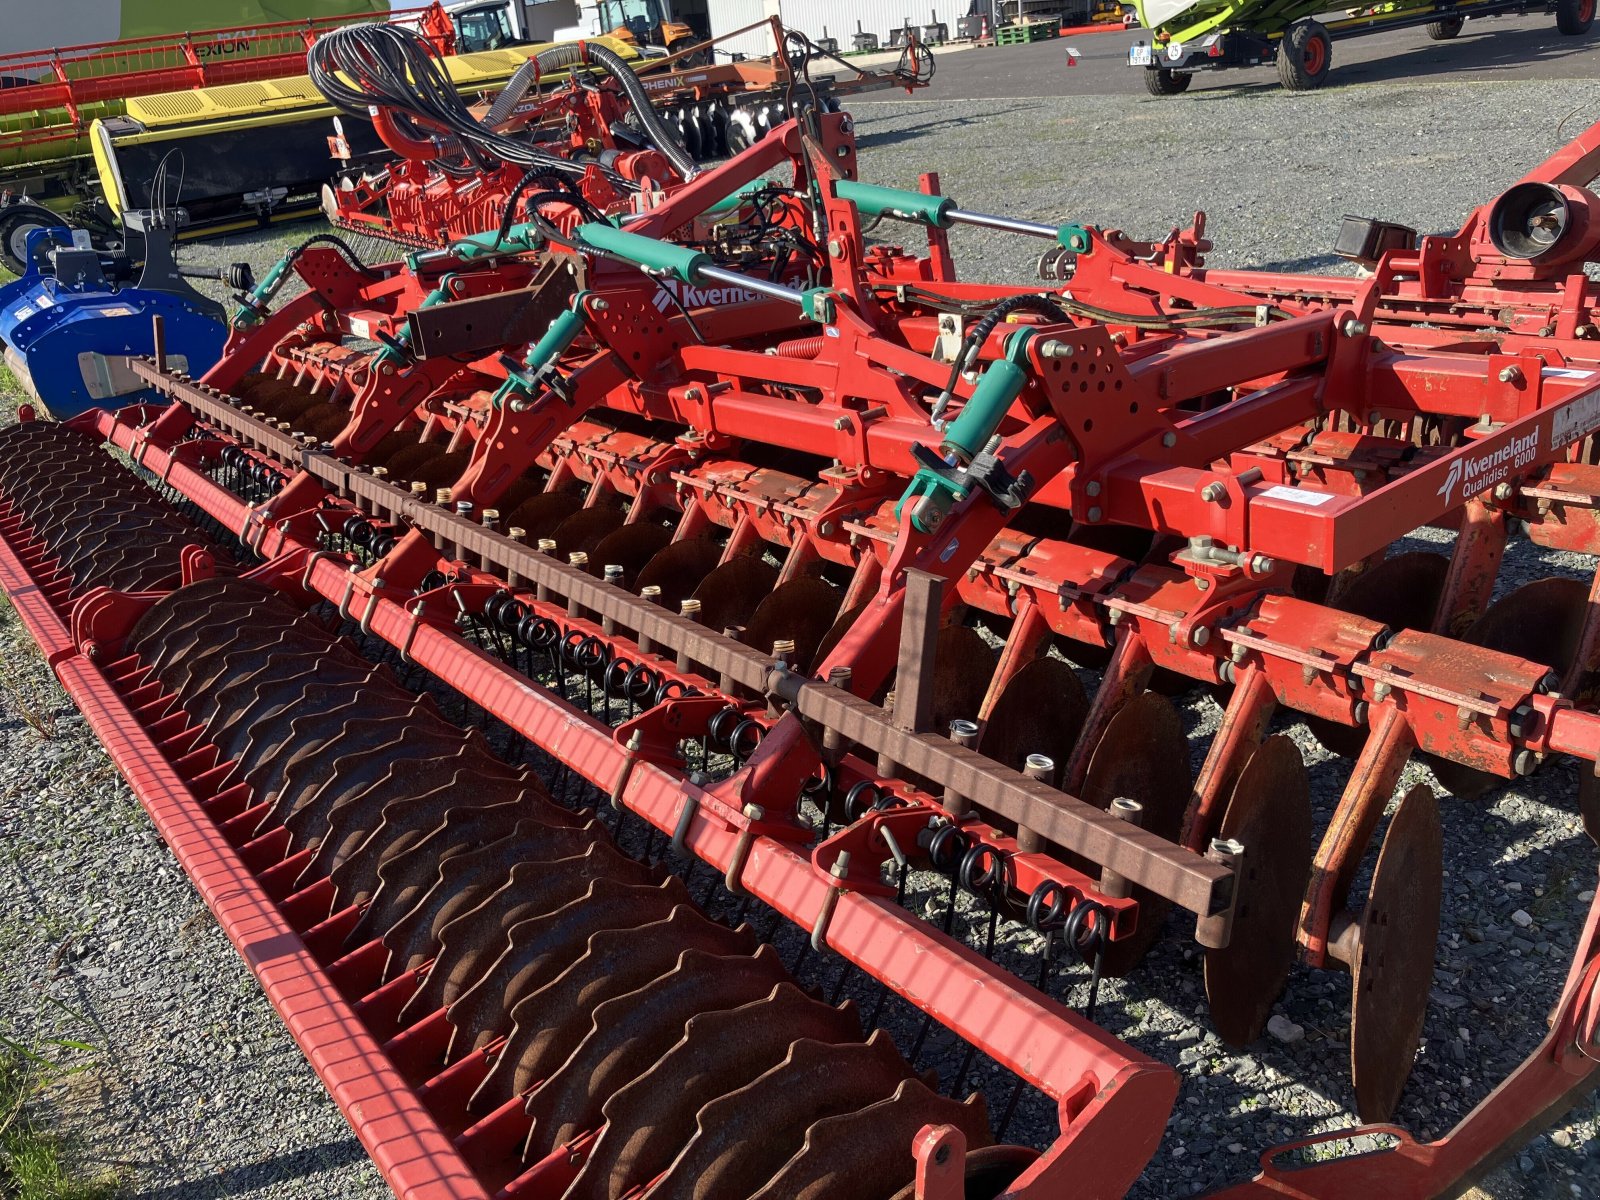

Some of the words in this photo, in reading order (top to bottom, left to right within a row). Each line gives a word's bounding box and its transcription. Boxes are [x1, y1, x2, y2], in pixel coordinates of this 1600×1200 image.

[194, 41, 250, 57] EXION
[1170, 45, 1179, 57] 25
[641, 76, 685, 90] PHENIX
[512, 103, 538, 113] AZOL
[1463, 425, 1539, 481] Kverneland
[1462, 466, 1508, 498] Qualidisc
[1514, 446, 1536, 469] 6000
